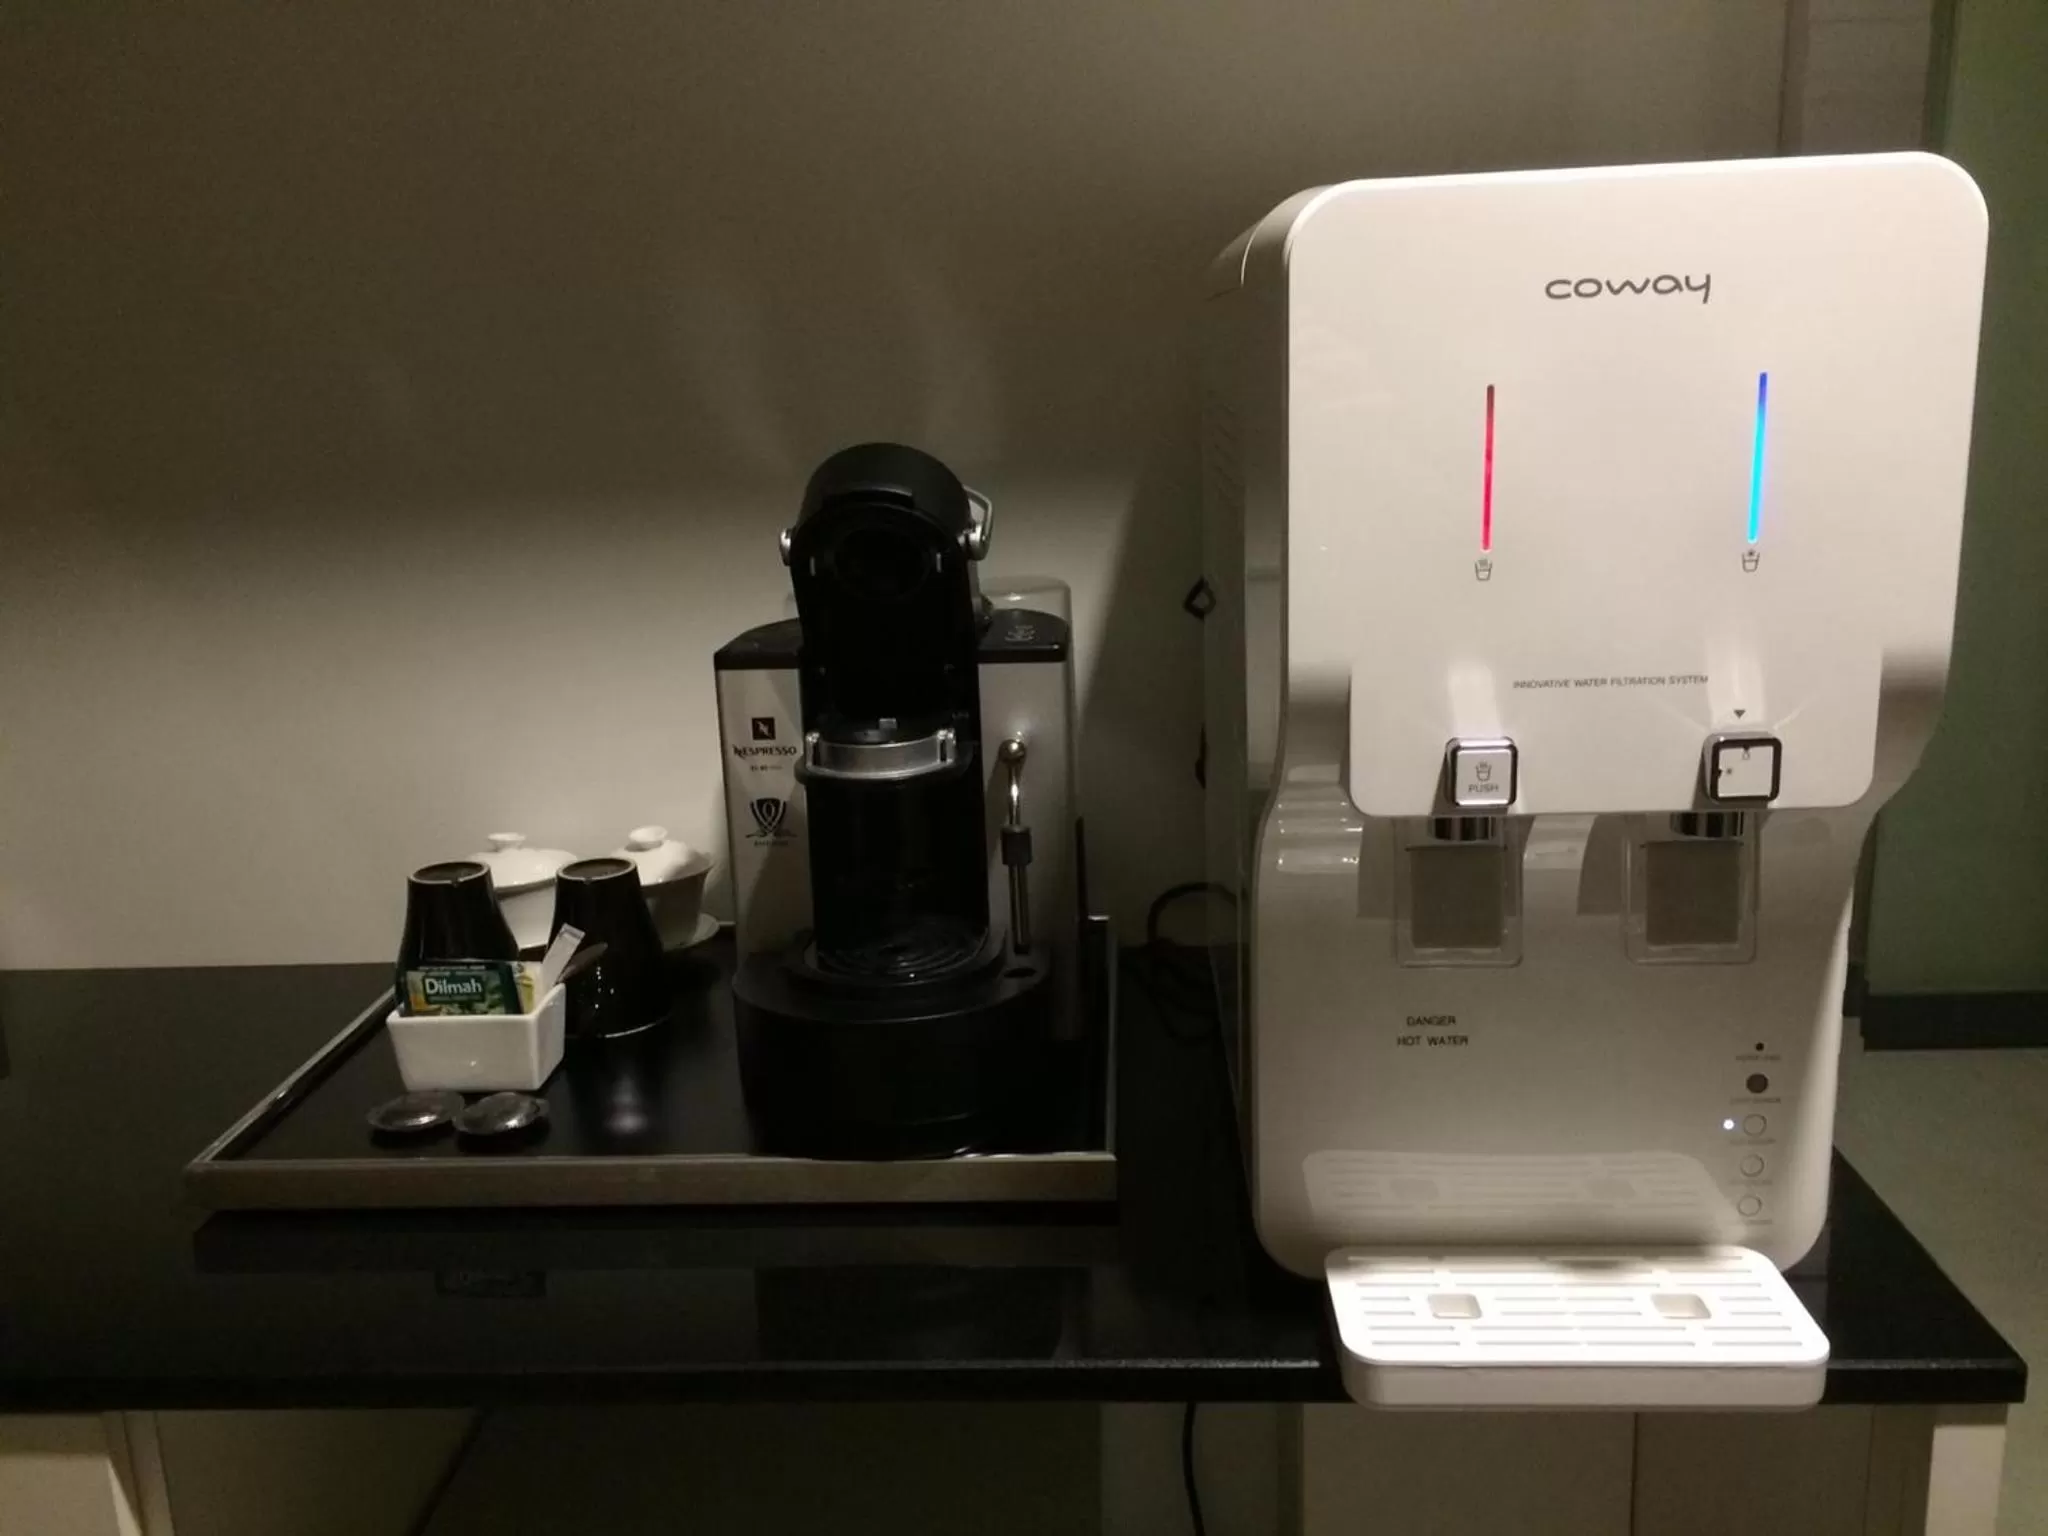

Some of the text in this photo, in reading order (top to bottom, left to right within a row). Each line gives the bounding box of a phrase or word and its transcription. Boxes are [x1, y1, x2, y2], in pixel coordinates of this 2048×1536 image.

[1545, 273, 1712, 304] coway
[1513, 675, 1709, 688] INNOVATIVE WATER FILTRATION SYSTEM
[733, 745, 797, 758] NESPRESSO
[1467, 783, 1500, 793] PUSH
[425, 978, 482, 994] Dilmah
[1406, 1015, 1457, 1026] DANGER
[1397, 1035, 1469, 1046] HOT WATER
